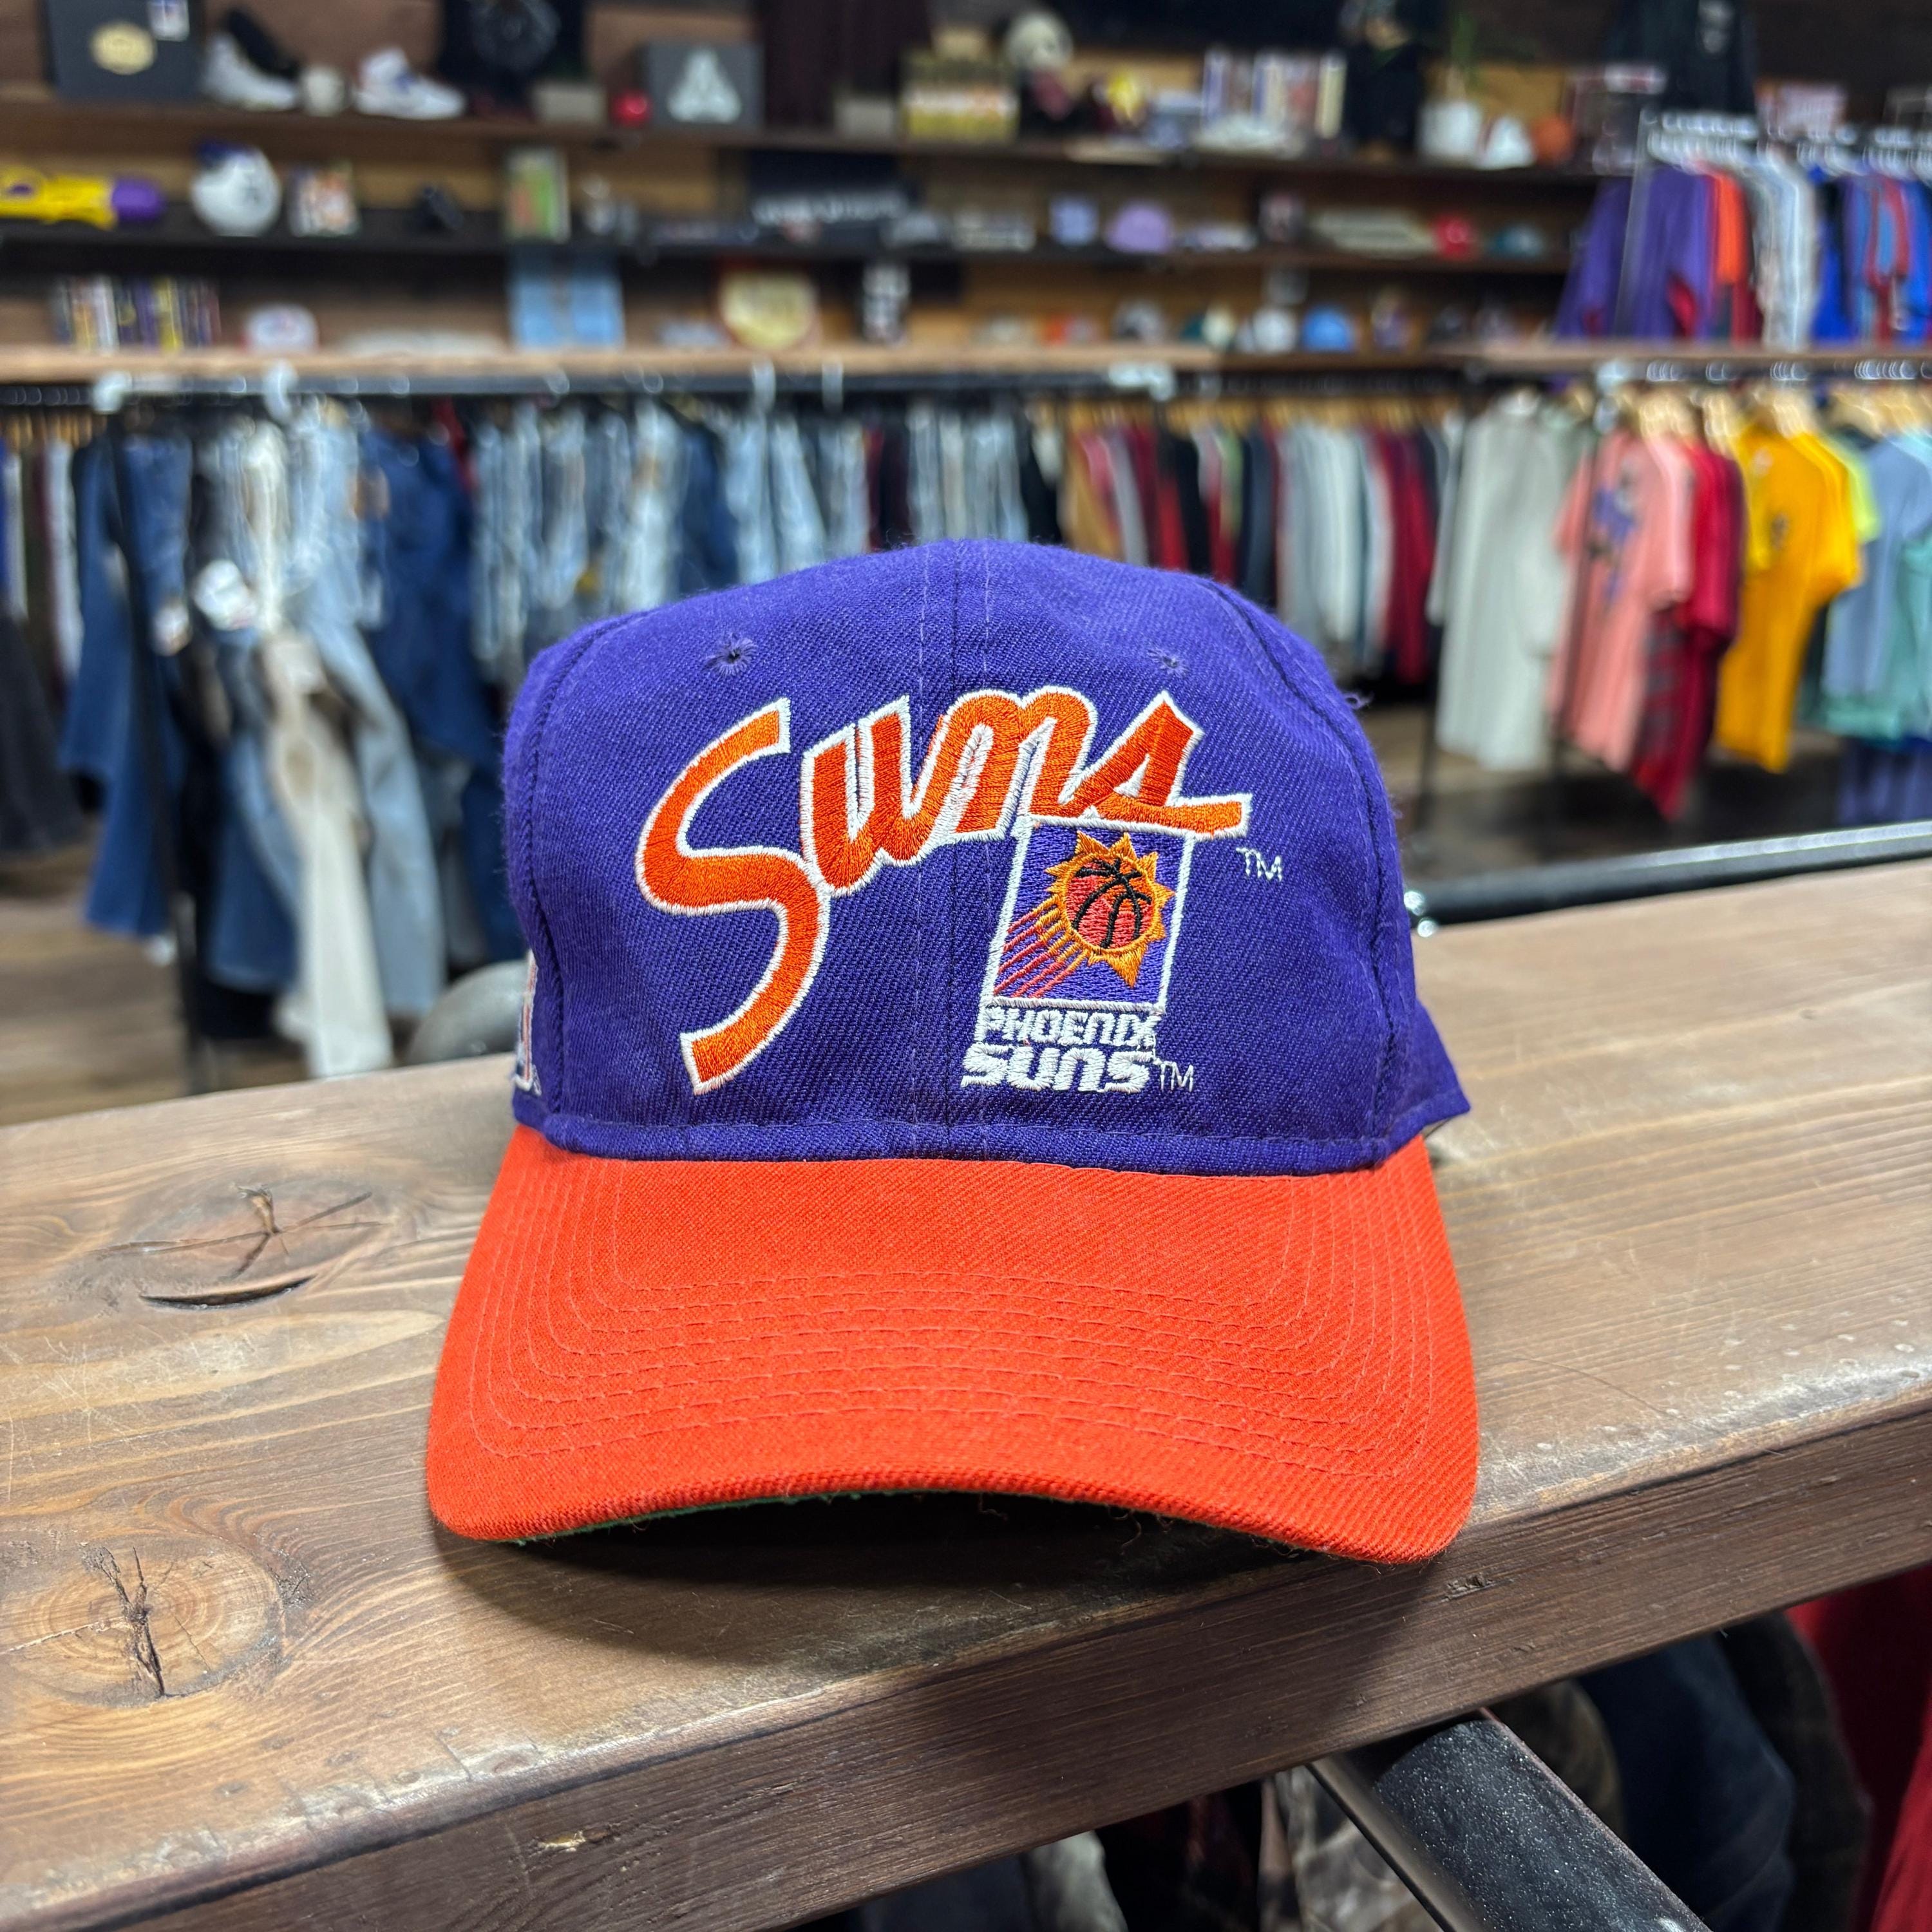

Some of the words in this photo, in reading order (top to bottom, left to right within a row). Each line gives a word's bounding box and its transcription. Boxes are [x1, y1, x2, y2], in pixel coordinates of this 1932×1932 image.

[1236, 848, 1282, 882] TM
[636, 686, 1253, 1095] Suns
[974, 1007, 1161, 1047] PHOENIX
[1155, 1061, 1194, 1093] TM
